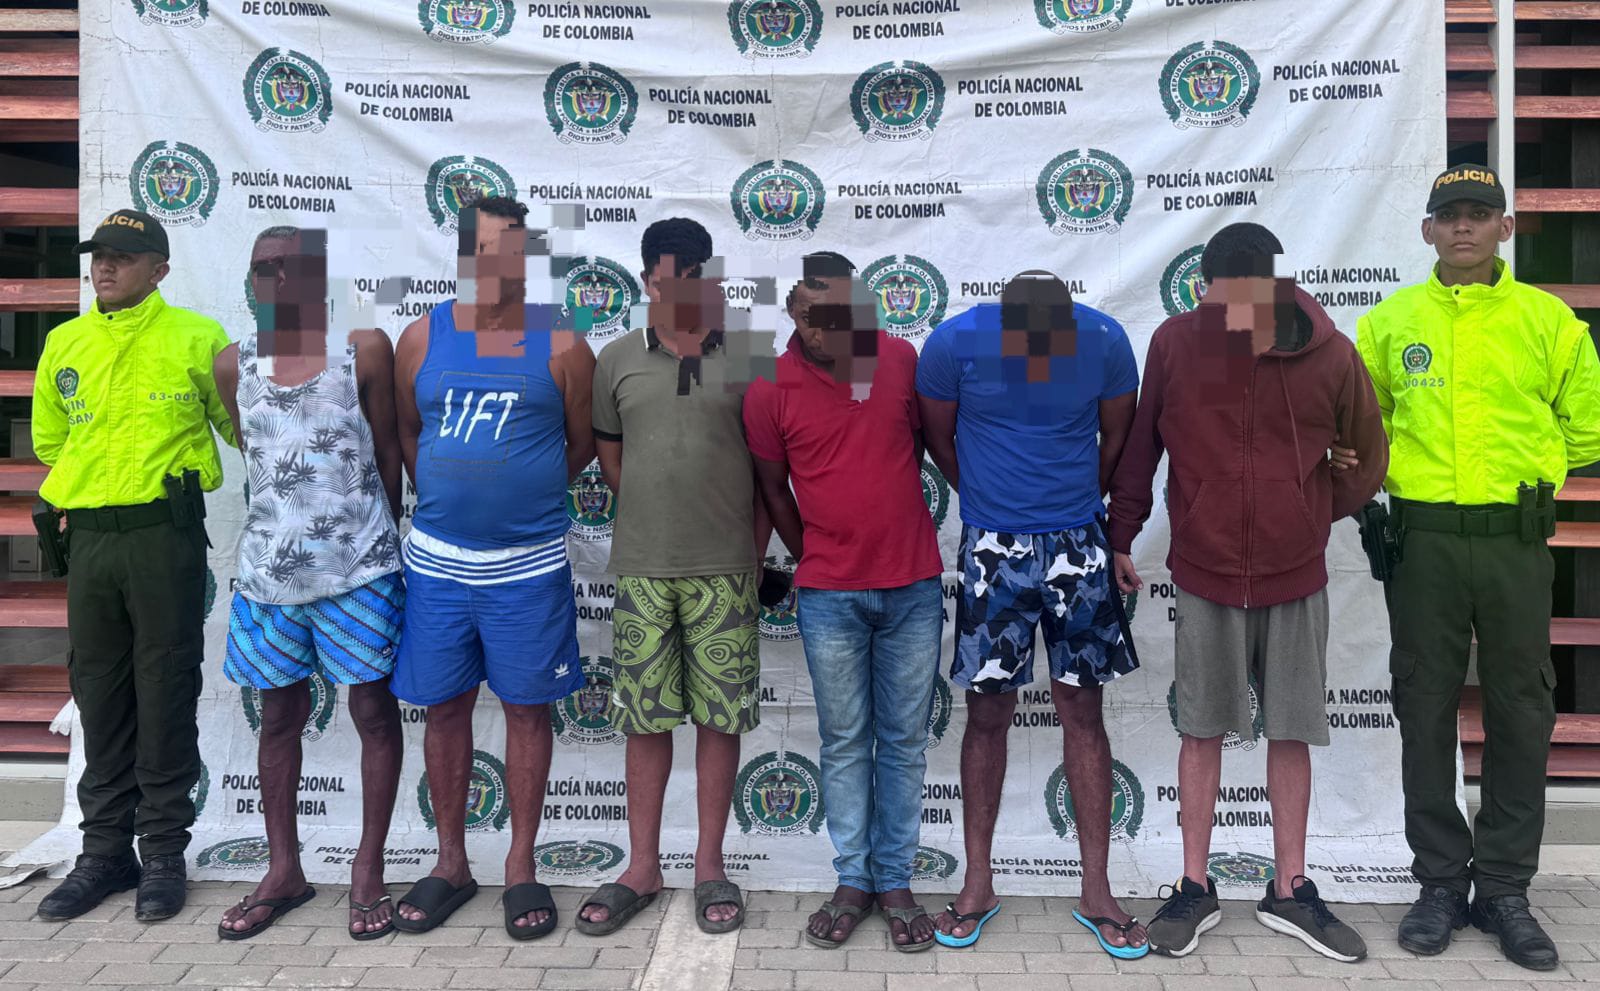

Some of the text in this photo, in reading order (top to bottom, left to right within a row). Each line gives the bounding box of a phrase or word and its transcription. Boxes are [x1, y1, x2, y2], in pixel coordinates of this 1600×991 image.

[242, 1, 331, 16] DE COLOMBIA
[529, 1, 650, 18] POLICÍA NACIONAL
[836, 0, 960, 17] POLICÍA NACIONAL
[543, 25, 633, 40] DE COLOMBIA
[853, 22, 944, 39] DE COLOMBIA
[1274, 59, 1400, 80] POLICÍA NACIONAL
[345, 80, 470, 99] POLICÍA NACIONAL
[958, 75, 1083, 94] POLICÍA NACIONAL
[649, 86, 771, 104] POLICÍA NACIONAL
[1290, 84, 1382, 103] DE COLOMBIA
[361, 103, 453, 122] DE COLOMBIA
[975, 101, 1066, 117] DE COLOMBIA
[668, 110, 756, 127] DE COLOMBIA
[232, 169, 352, 190] POLICÍA NACIONAL
[1147, 167, 1274, 188] POLICÍA NACIONAL
[1435, 168, 1495, 190] POLICIA
[530, 181, 652, 199] POLICÍA NACIONAL
[839, 181, 962, 197] POLICÍA NACIONAL
[249, 195, 335, 212] DE COLOMBIA
[1164, 191, 1257, 211] DE COLOMBIA
[586, 207, 637, 222] LOMBIA
[855, 203, 945, 219] DE COLOMBIA
[103, 215, 145, 232] LICIA
[1294, 264, 1400, 284] LICÍA NACIONAL
[406, 280, 457, 295] NACION
[961, 277, 1006, 296] POLICÍ
[439, 387, 520, 444] LIFT
[1340, 689, 1391, 704] NACION
[1012, 712, 1061, 727] OLOMB
[1326, 713, 1395, 728] OLOMBIA
[222, 774, 345, 792] POLIC CIONAL
[546, 775, 626, 796] LICÍA NACIO
[1112, 771, 1133, 806] OLOMBIA
[921, 784, 962, 800] CIONA
[1217, 786, 1270, 802] NACION
[236, 799, 254, 813] DE
[543, 805, 628, 820] DE COLOMBI
[315, 846, 359, 854] POLIC
[659, 852, 695, 861] LICÍA
[323, 856, 346, 864] DE
[992, 857, 1079, 867] LICÍA NACIO
[1306, 863, 1368, 874] POLICÍA
[1014, 868, 1083, 877] COLOMBI
[1332, 874, 1355, 883] DE
